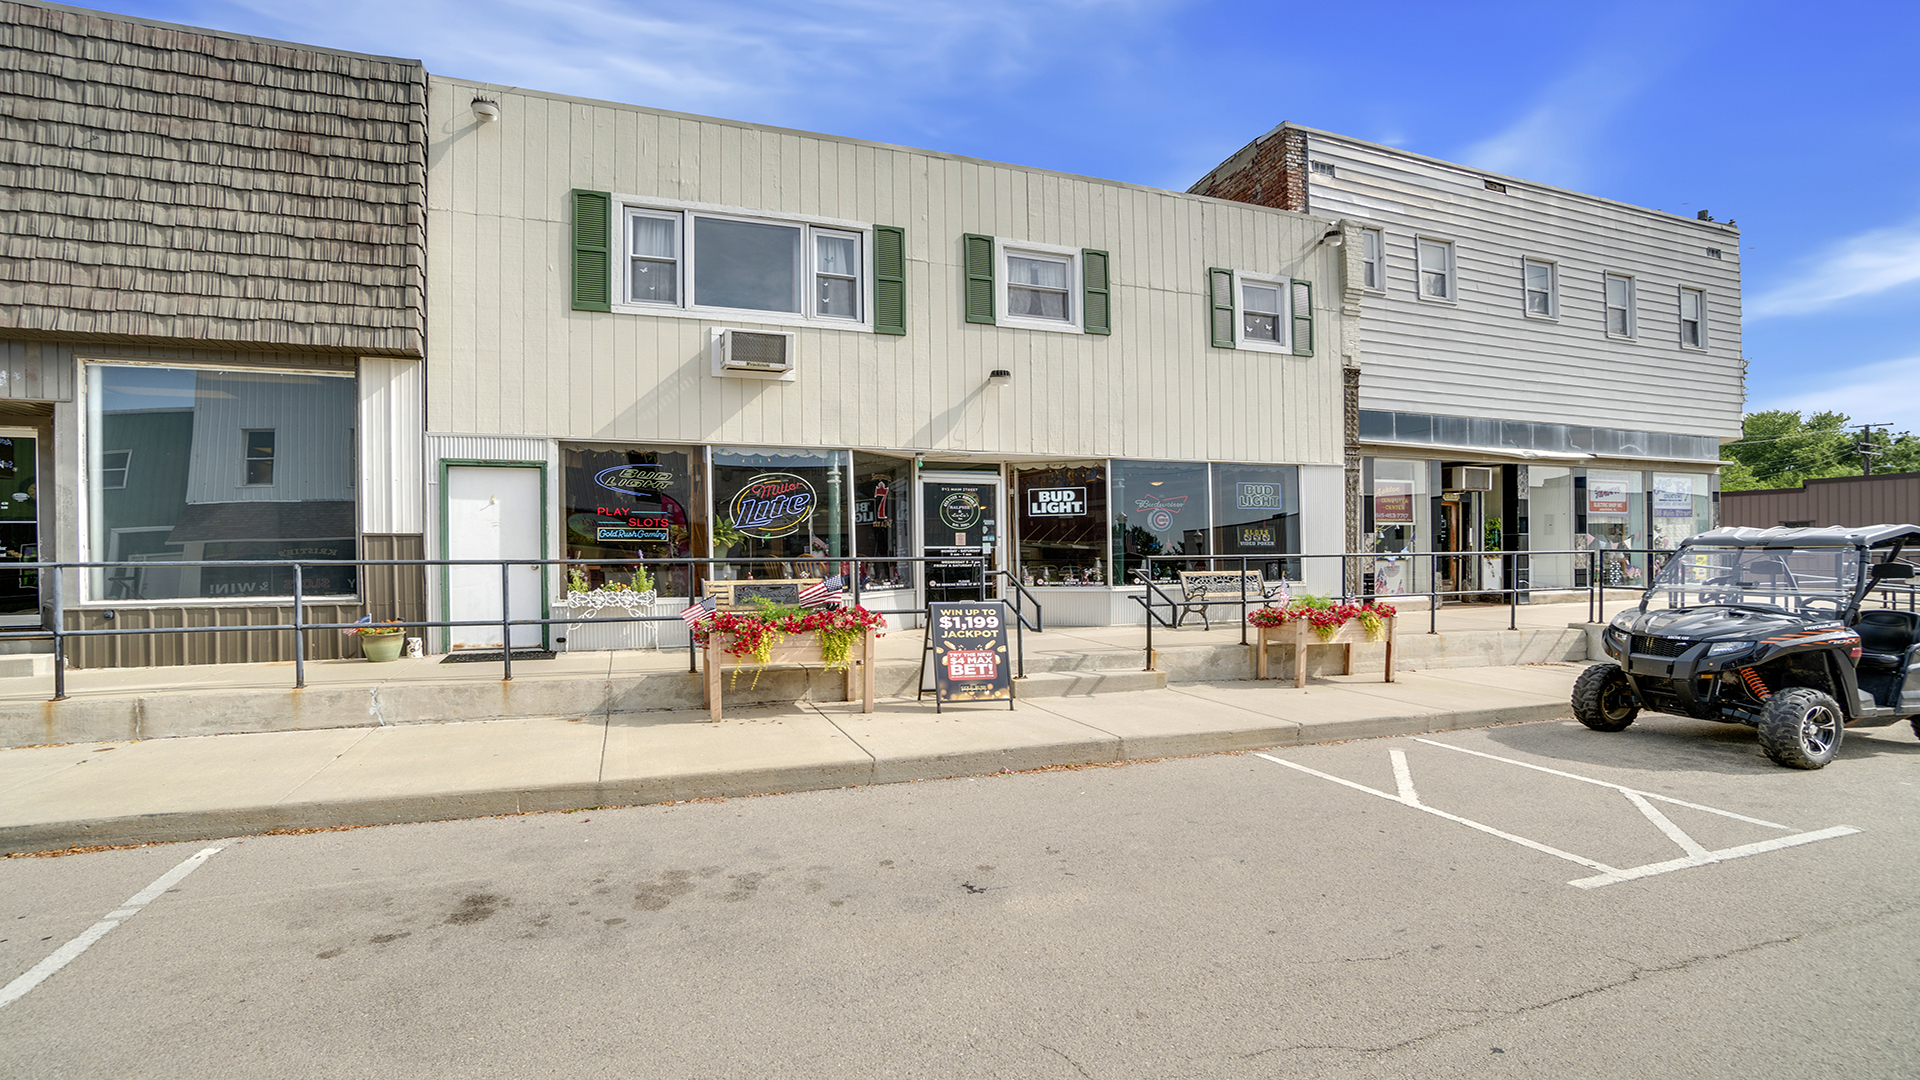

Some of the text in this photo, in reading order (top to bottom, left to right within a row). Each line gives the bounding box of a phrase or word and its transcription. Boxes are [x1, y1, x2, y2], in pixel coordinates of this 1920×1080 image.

[751, 482, 804, 499] Miller
[1244, 484, 1274, 496] BUD
[1038, 490, 1076, 502] BUD
[1135, 499, 1186, 508] Budweiser
[1239, 496, 1280, 507] LIGHT
[596, 506, 630, 516] PLAY
[732, 493, 811, 529] Lite
[628, 518, 669, 528] SLOTS
[965, 608, 980, 616] UP
[982, 608, 997, 616] TO
[939, 615, 1000, 630] $1,199
[1803, 622, 1842, 631] PROWLER
[941, 630, 1000, 638] JACKPOT
[950, 656, 993, 665] $4 MAX
[950, 664, 994, 676] BET!
